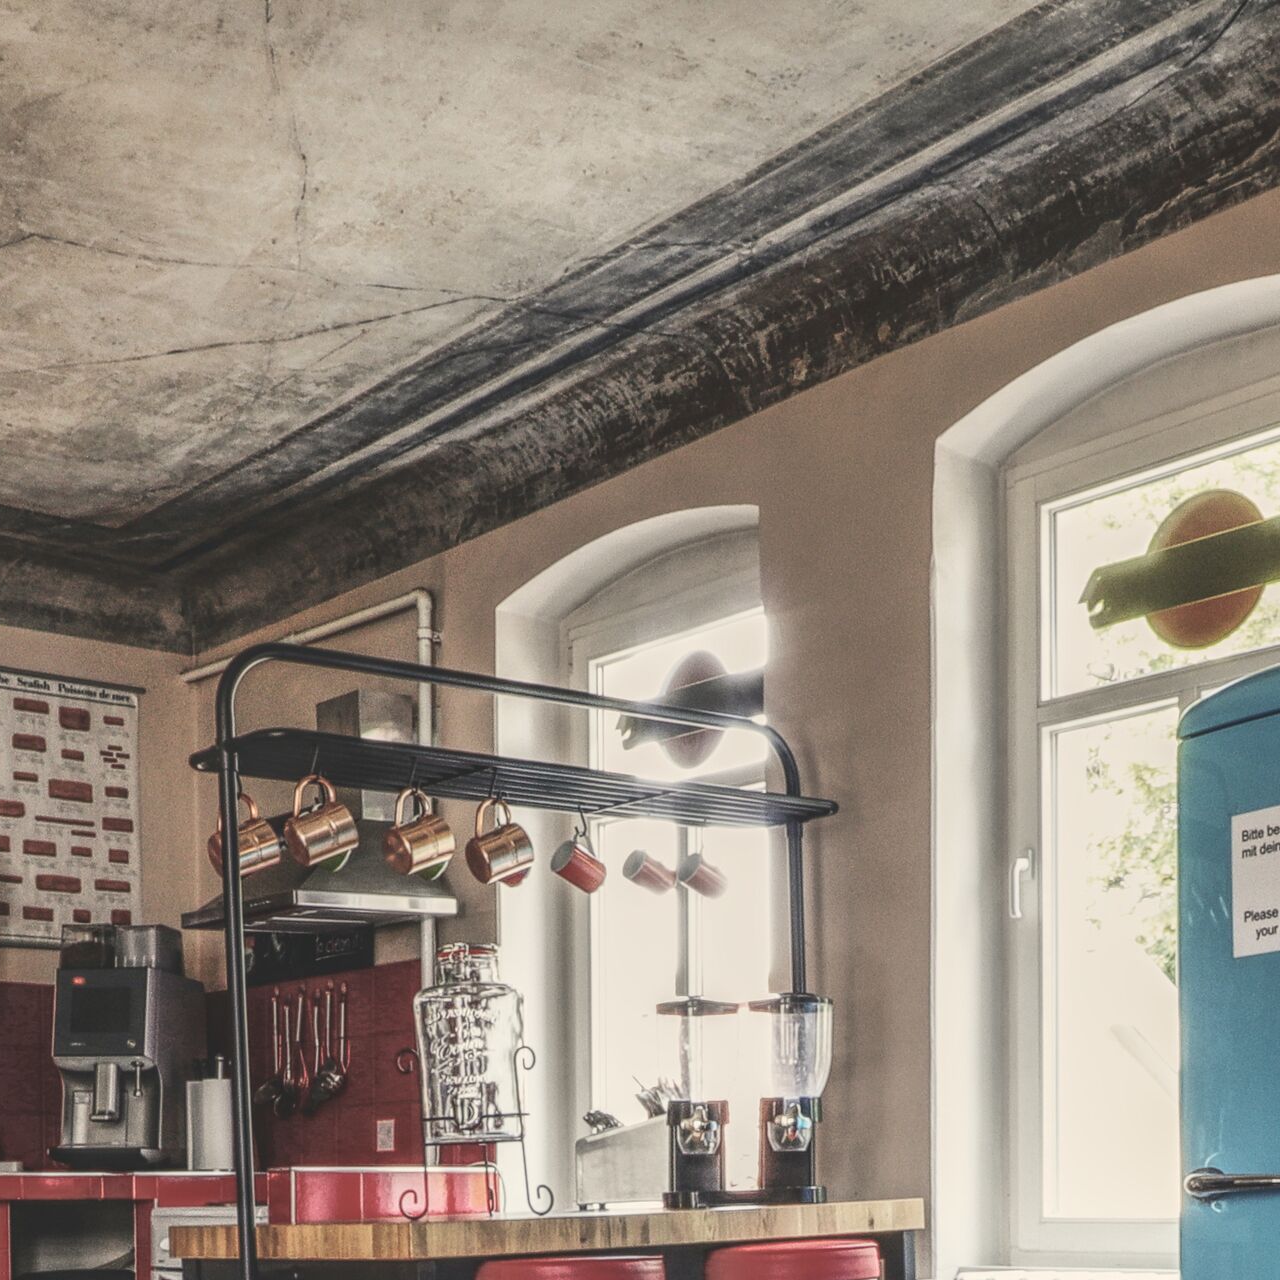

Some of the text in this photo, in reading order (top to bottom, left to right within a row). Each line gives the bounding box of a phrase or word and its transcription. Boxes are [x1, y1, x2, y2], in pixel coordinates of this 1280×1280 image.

[17, 677, 50, 691] Seafish
[99, 689, 110, 699] de
[1241, 828, 1264, 842] Bitte
[1241, 845, 1258, 859] mit
[1244, 907, 1279, 922] Please
[1255, 923, 1279, 940] your
